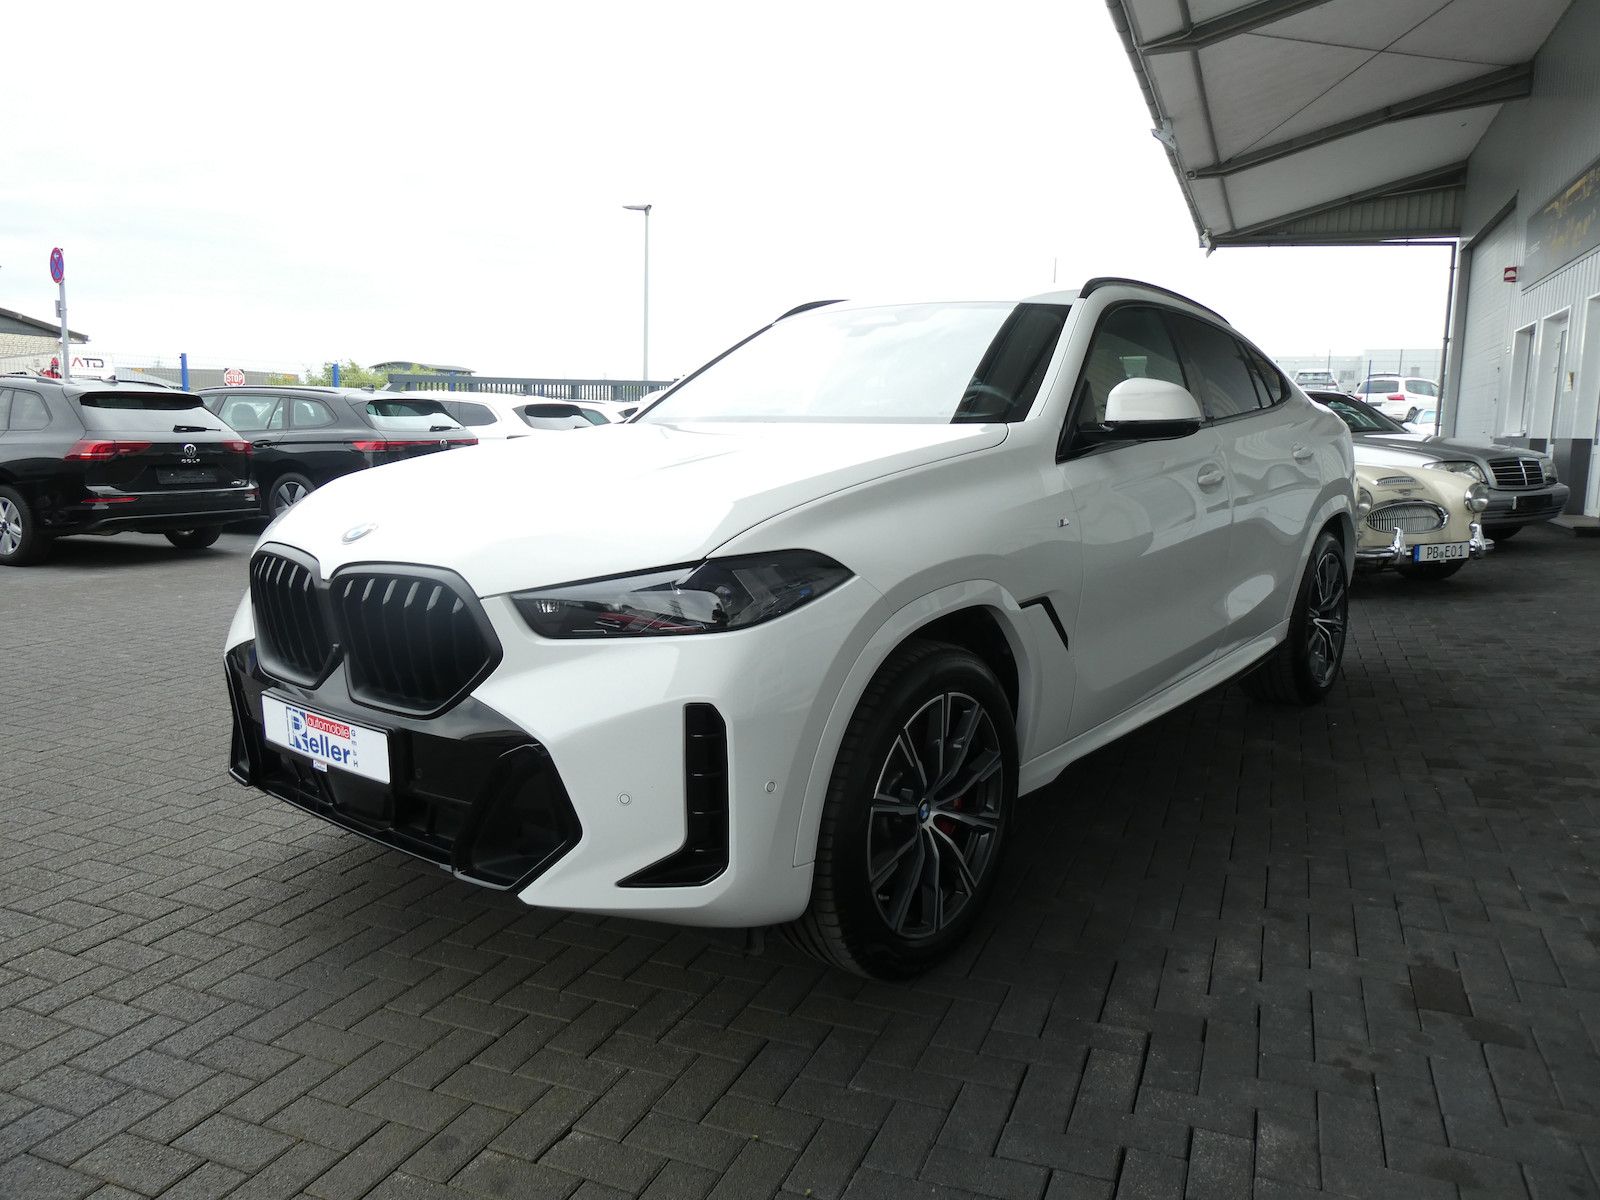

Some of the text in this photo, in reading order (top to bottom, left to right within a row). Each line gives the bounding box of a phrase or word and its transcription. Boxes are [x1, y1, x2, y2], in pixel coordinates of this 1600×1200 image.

[226, 374, 243, 383] STOP
[1426, 546, 1439, 559] PB
[307, 716, 350, 739] automobile
